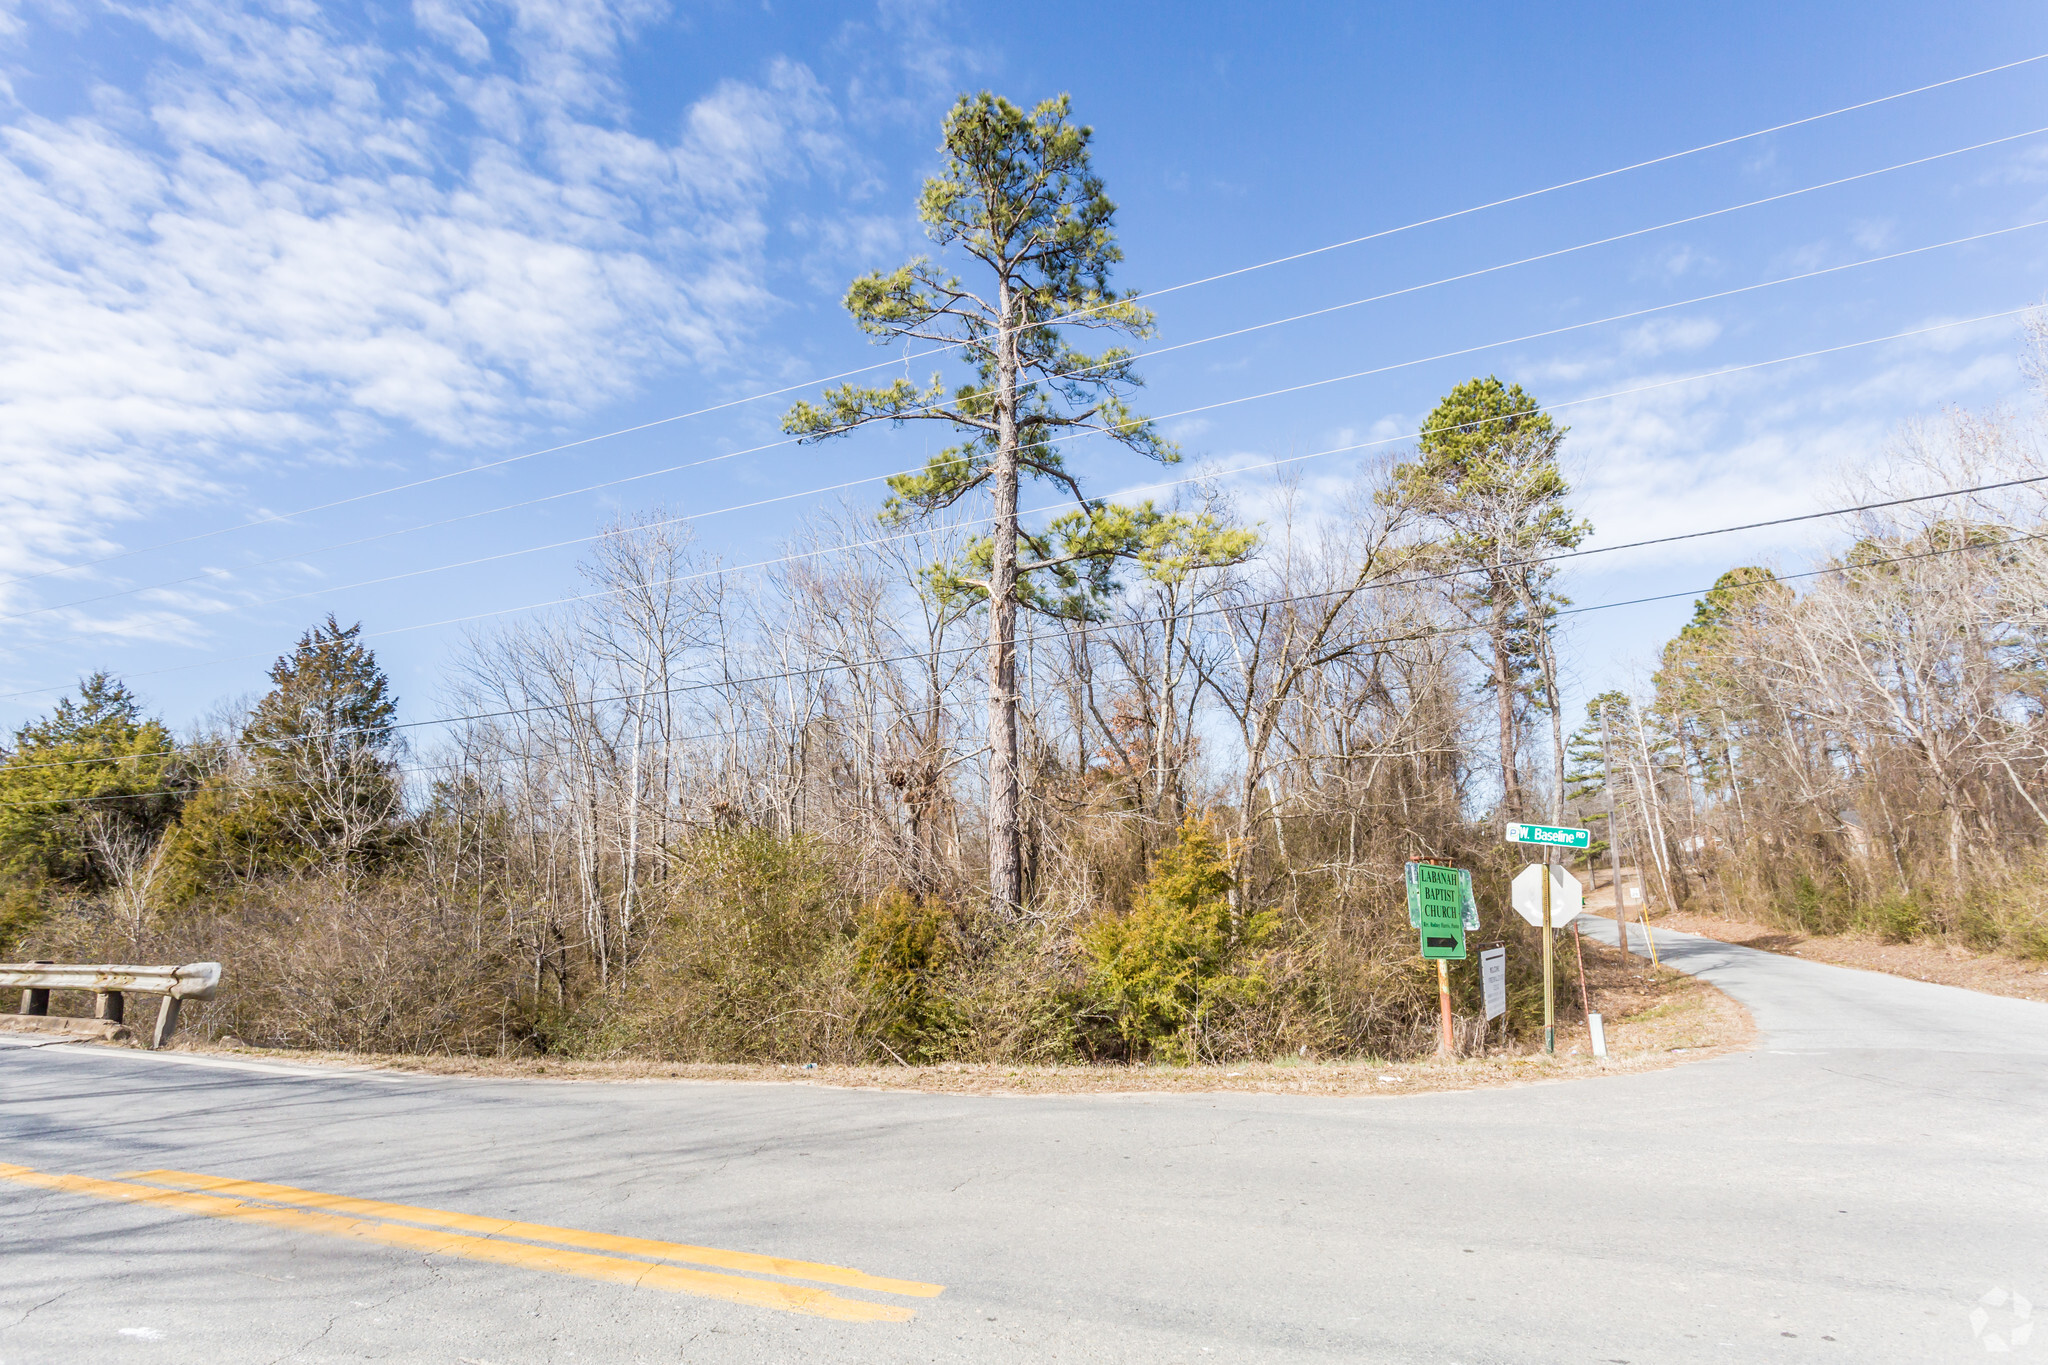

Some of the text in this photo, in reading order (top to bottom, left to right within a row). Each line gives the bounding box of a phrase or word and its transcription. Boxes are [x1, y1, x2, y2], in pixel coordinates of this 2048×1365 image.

[1520, 827, 1530, 839] W.
[1534, 828, 1575, 843] Baseline
[1421, 869, 1457, 886] LABANAH
[1425, 887, 1455, 902] BAPTIST
[1424, 904, 1457, 919] CHURCH
